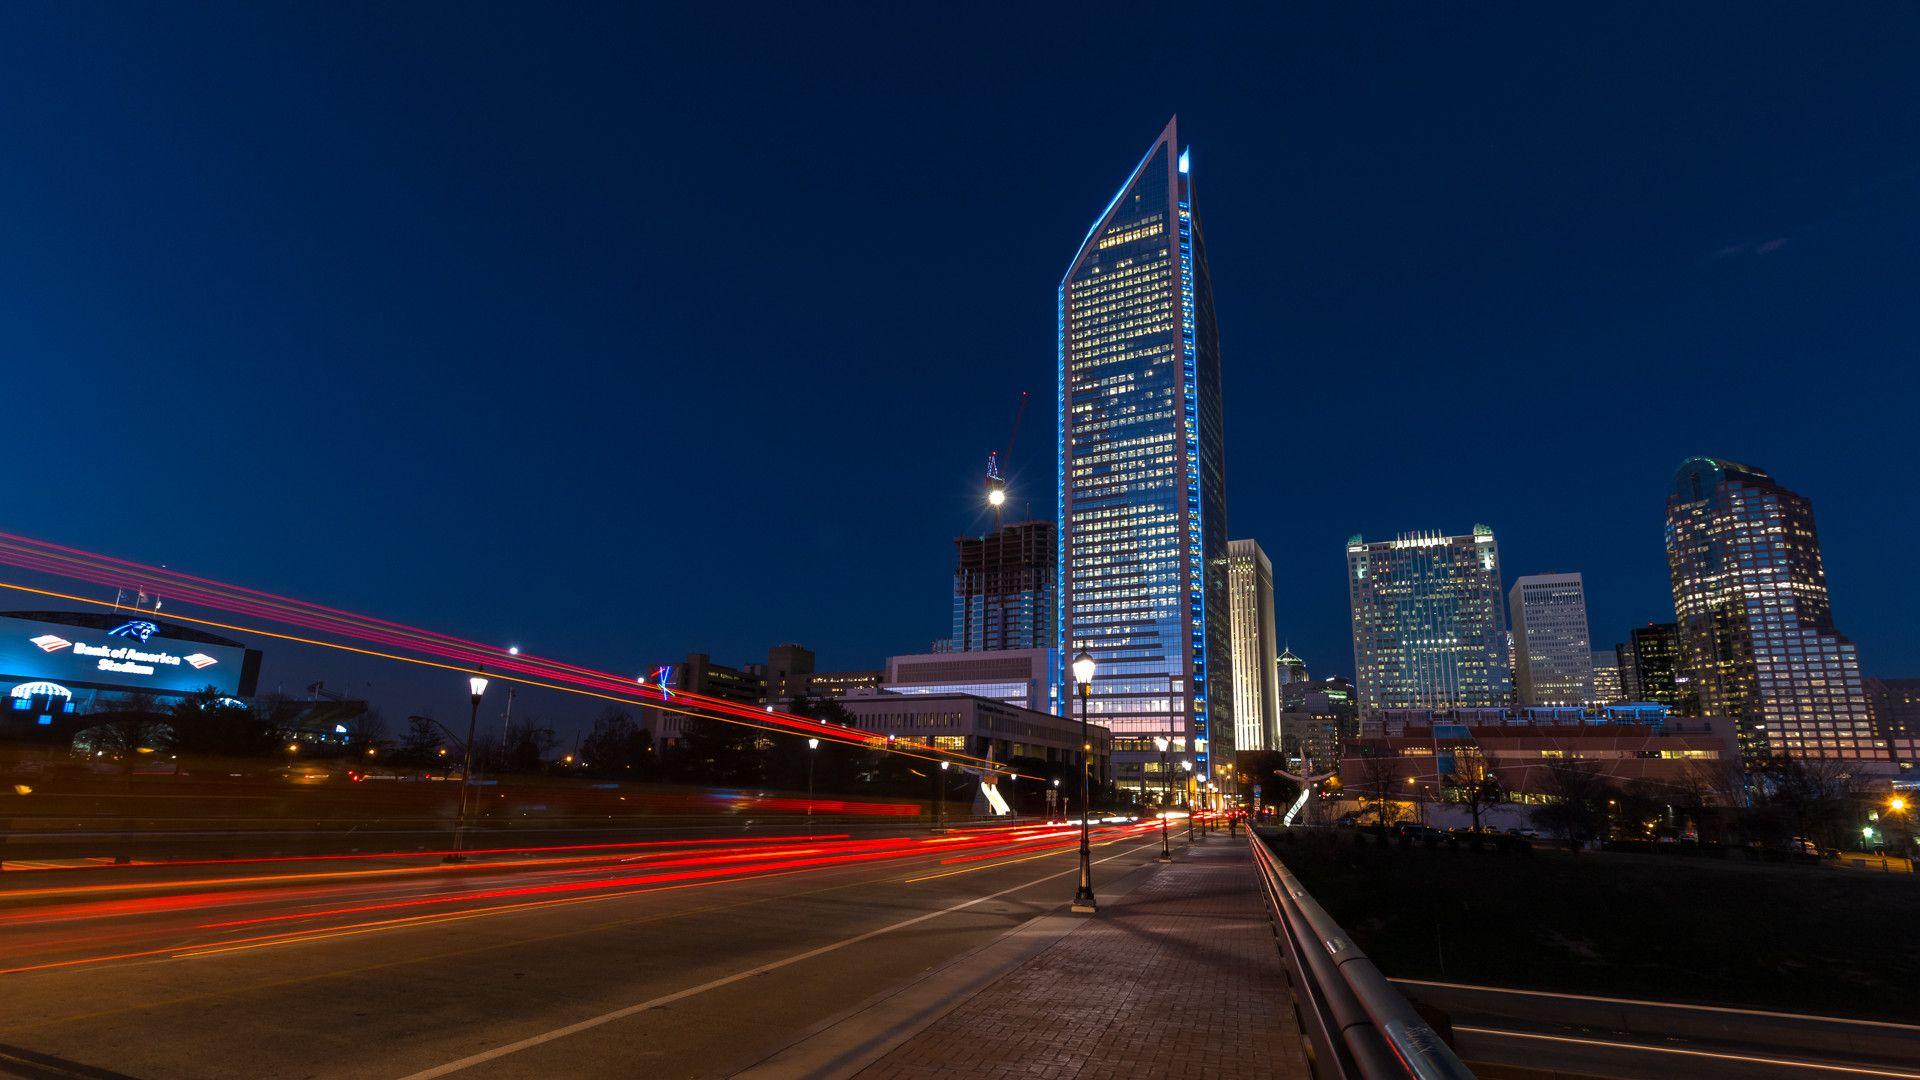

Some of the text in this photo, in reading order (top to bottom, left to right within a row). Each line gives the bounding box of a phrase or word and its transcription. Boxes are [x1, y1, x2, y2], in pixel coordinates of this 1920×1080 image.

[73, 642, 180, 665] Bank of America
[97, 659, 154, 675] Stadium
